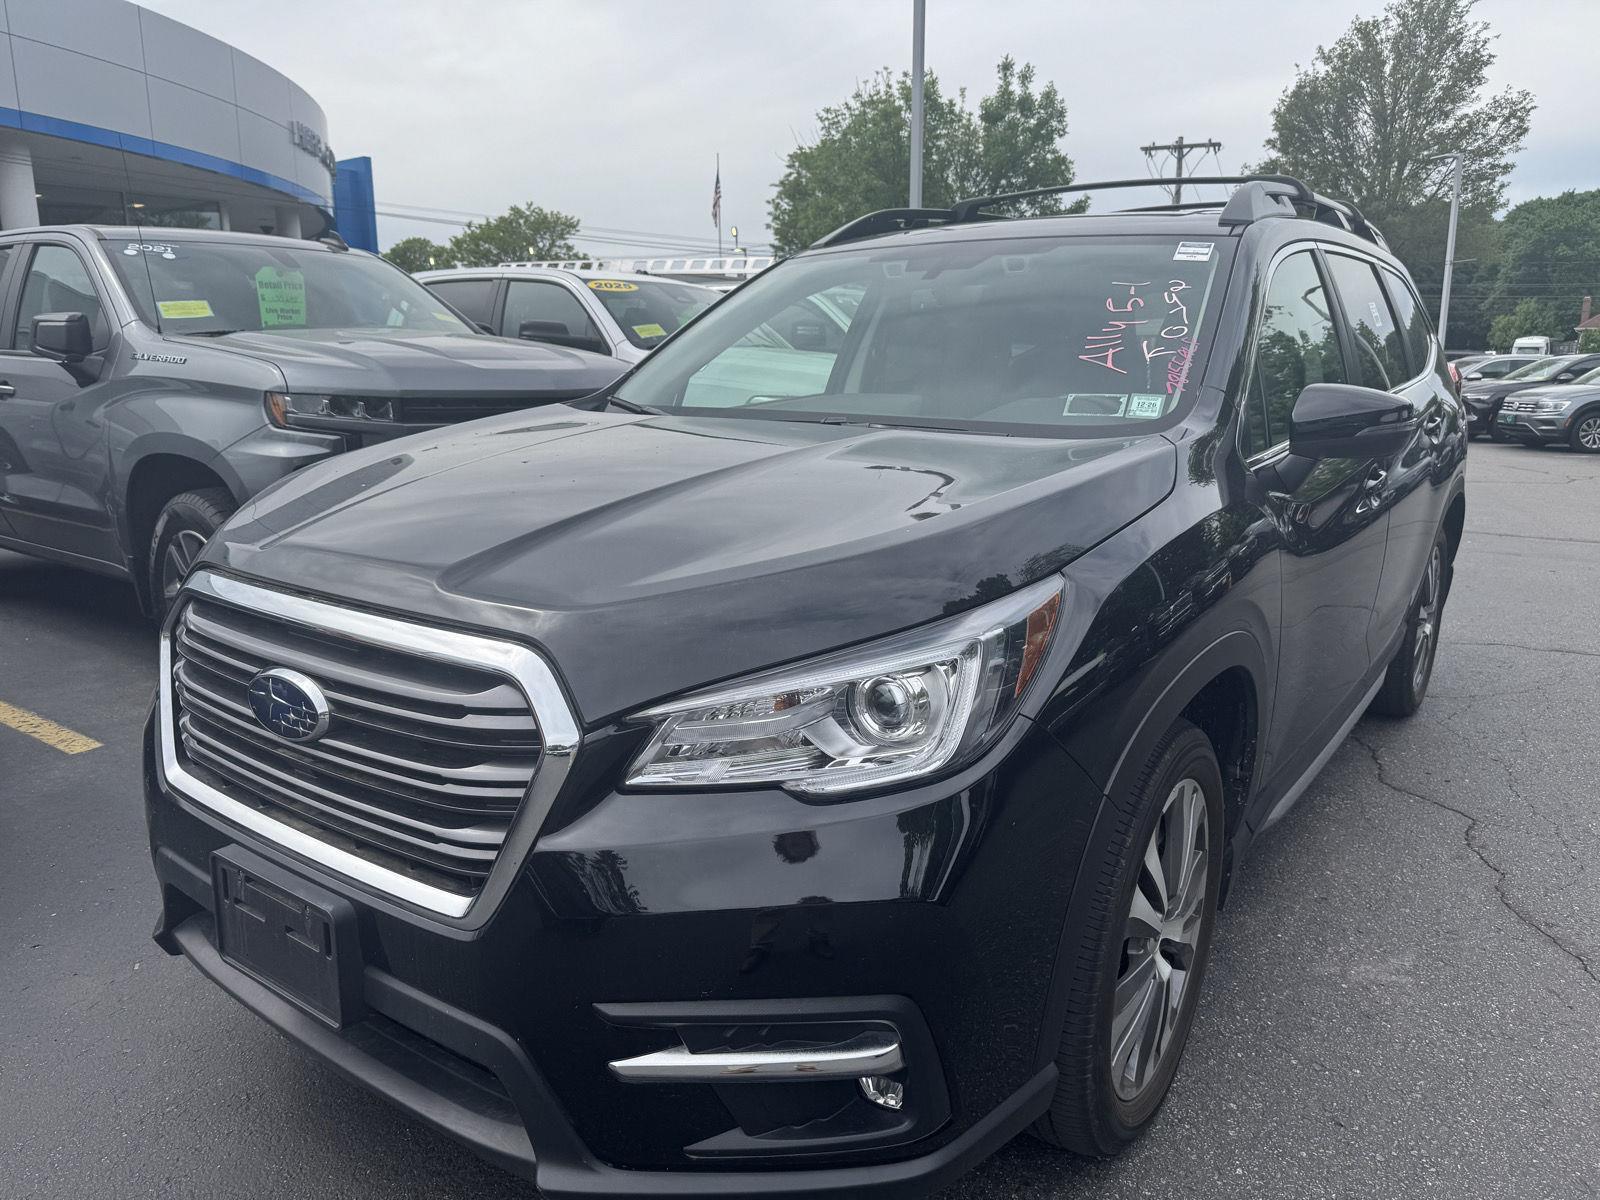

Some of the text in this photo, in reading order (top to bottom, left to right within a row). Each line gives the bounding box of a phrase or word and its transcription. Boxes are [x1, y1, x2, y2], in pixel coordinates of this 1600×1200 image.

[127, 243, 173, 254] 2021
[594, 281, 632, 289] 2025
[130, 353, 188, 364] SILVERADO
